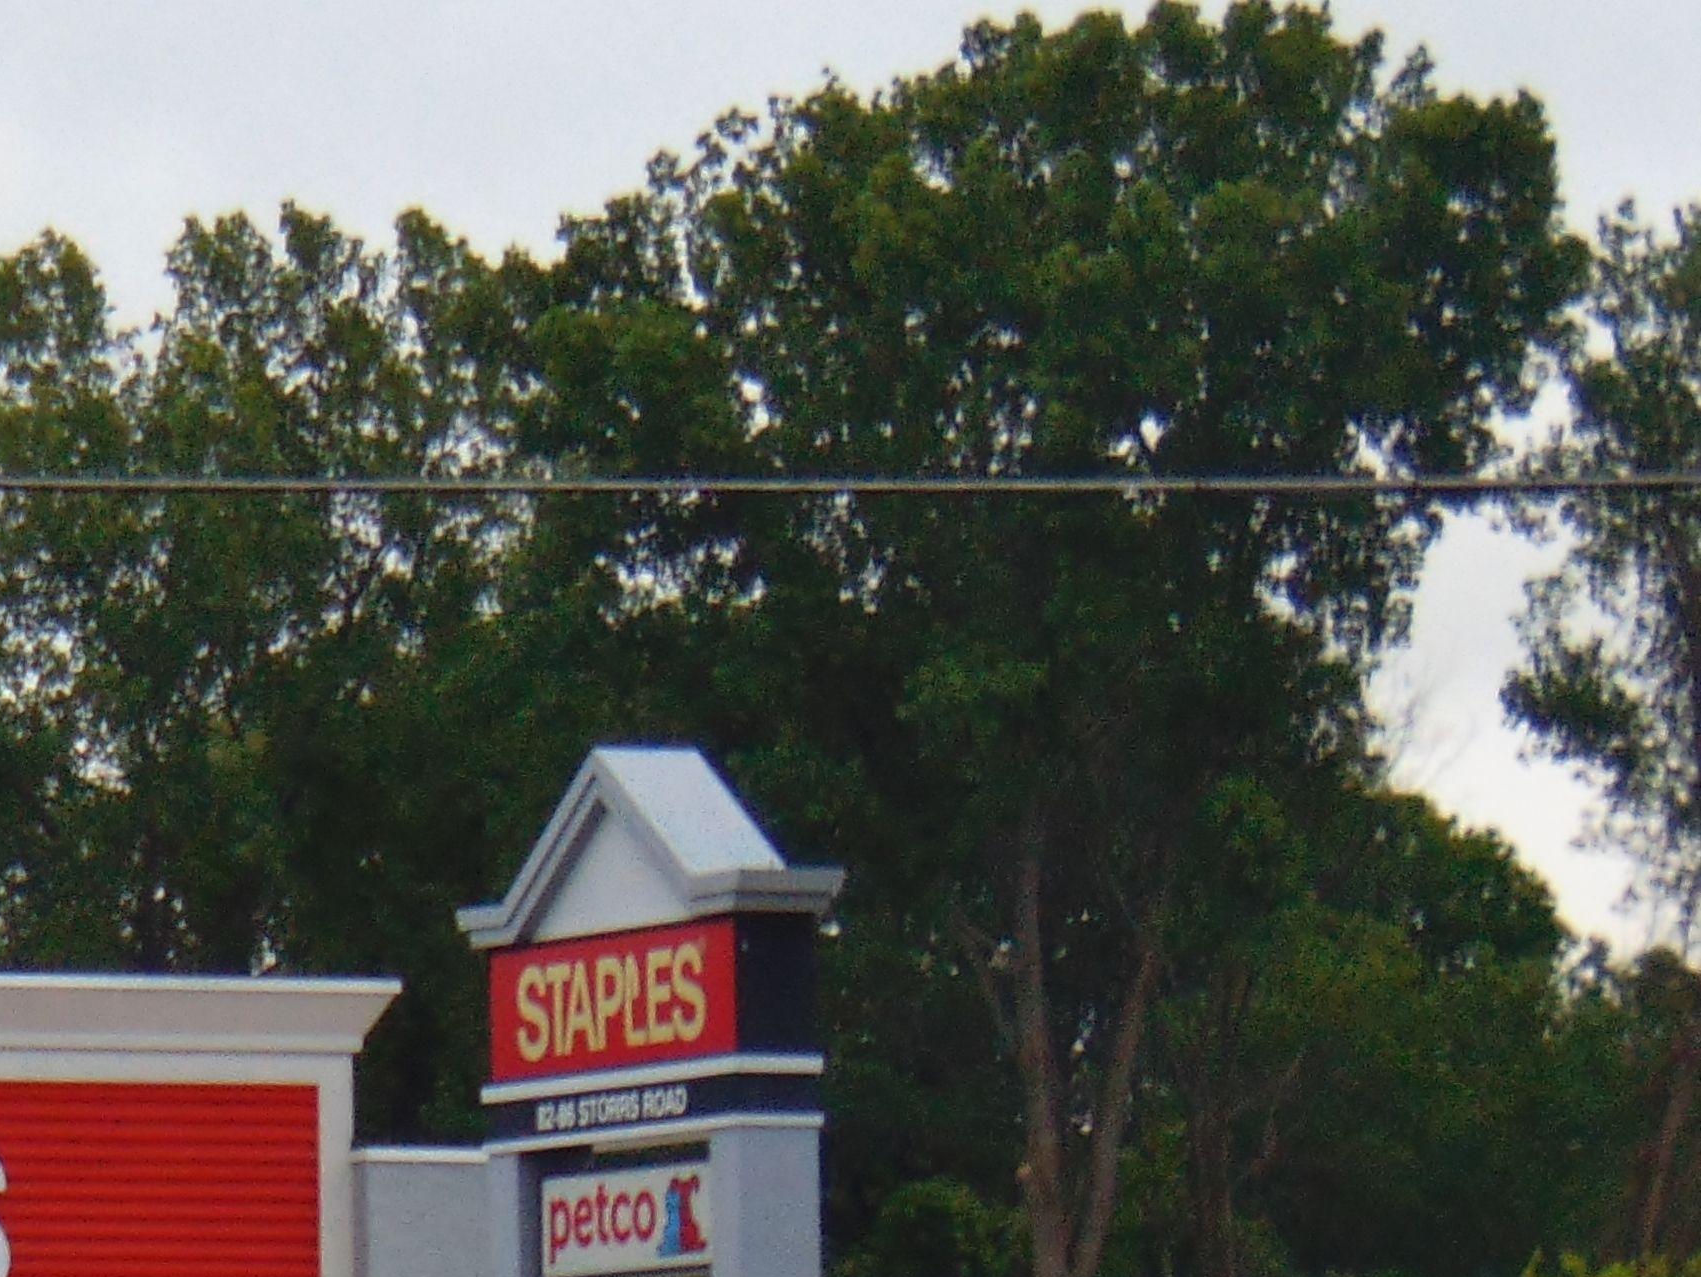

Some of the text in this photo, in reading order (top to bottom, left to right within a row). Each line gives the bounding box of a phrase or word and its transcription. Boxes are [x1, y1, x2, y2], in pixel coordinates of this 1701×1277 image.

[516, 942, 706, 1063] STAPLES
[642, 1082, 688, 1119] ROAD
[548, 1184, 658, 1265] petco
